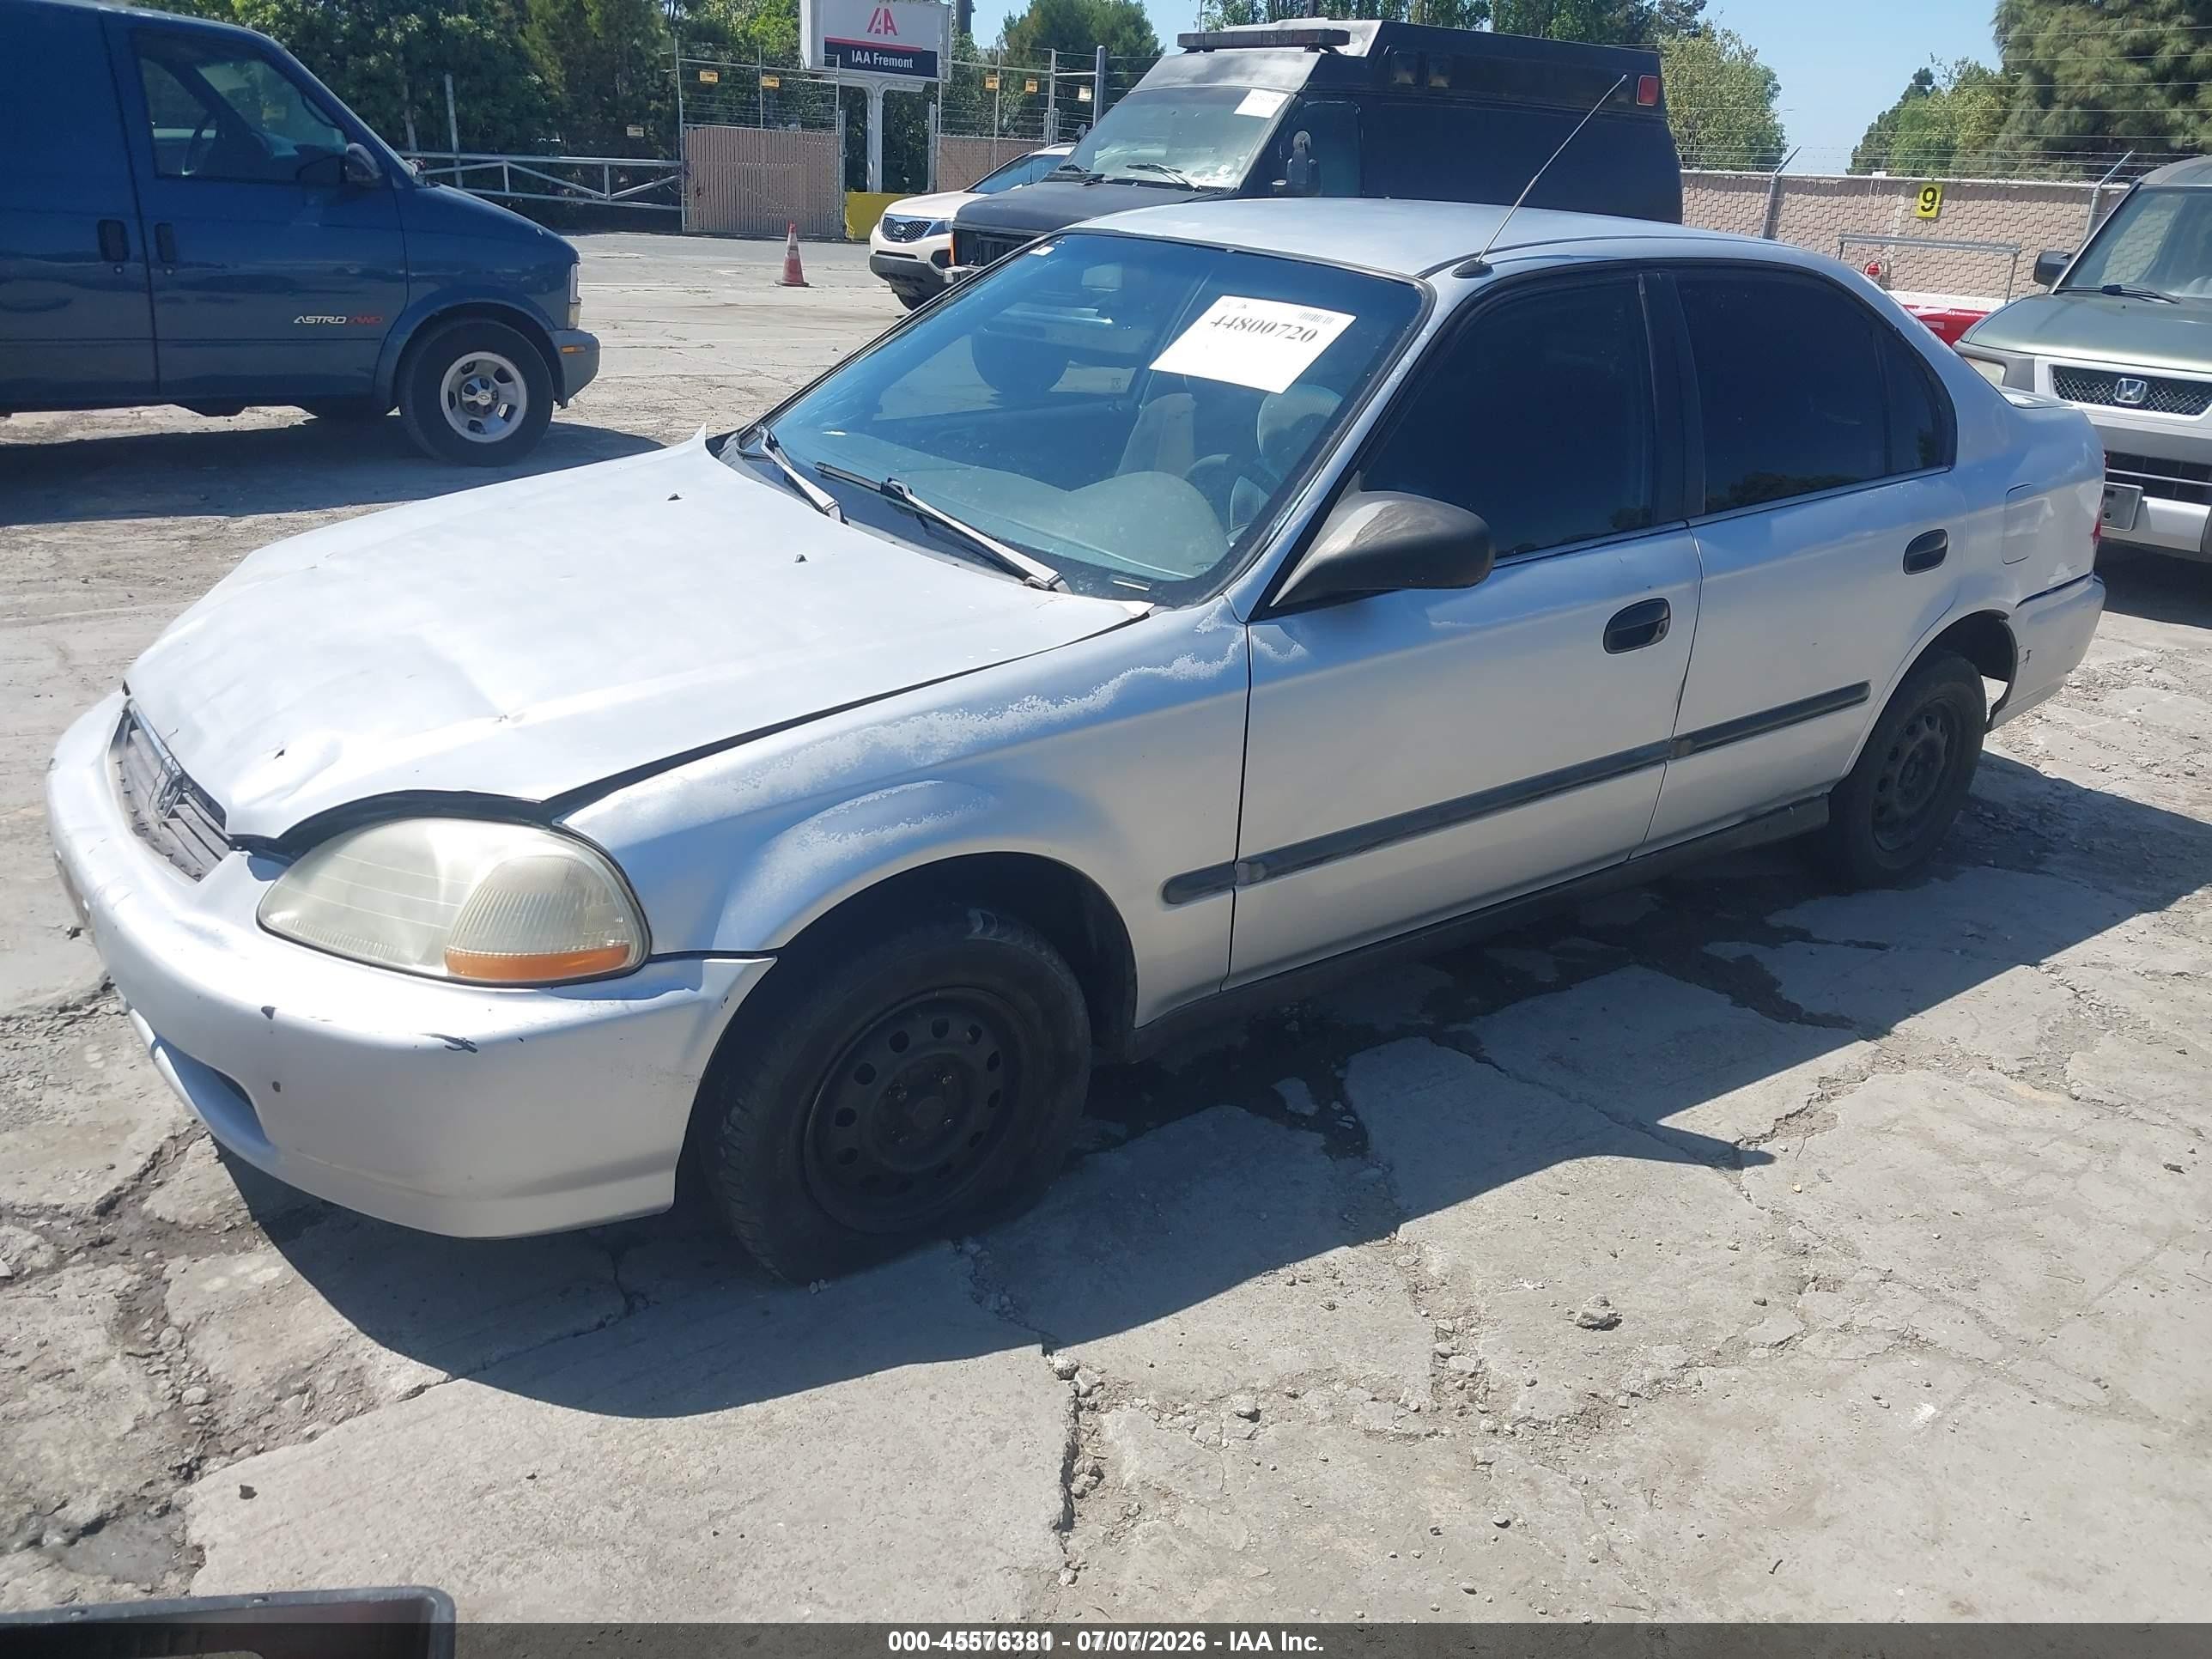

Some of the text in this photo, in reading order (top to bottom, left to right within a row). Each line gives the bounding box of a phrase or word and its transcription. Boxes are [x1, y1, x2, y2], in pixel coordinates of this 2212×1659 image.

[852, 49, 914, 69] IAA Fremont
[1920, 186, 1937, 212] 9
[293, 315, 348, 324] ASTRO
[1210, 314, 1318, 343] 44800720
